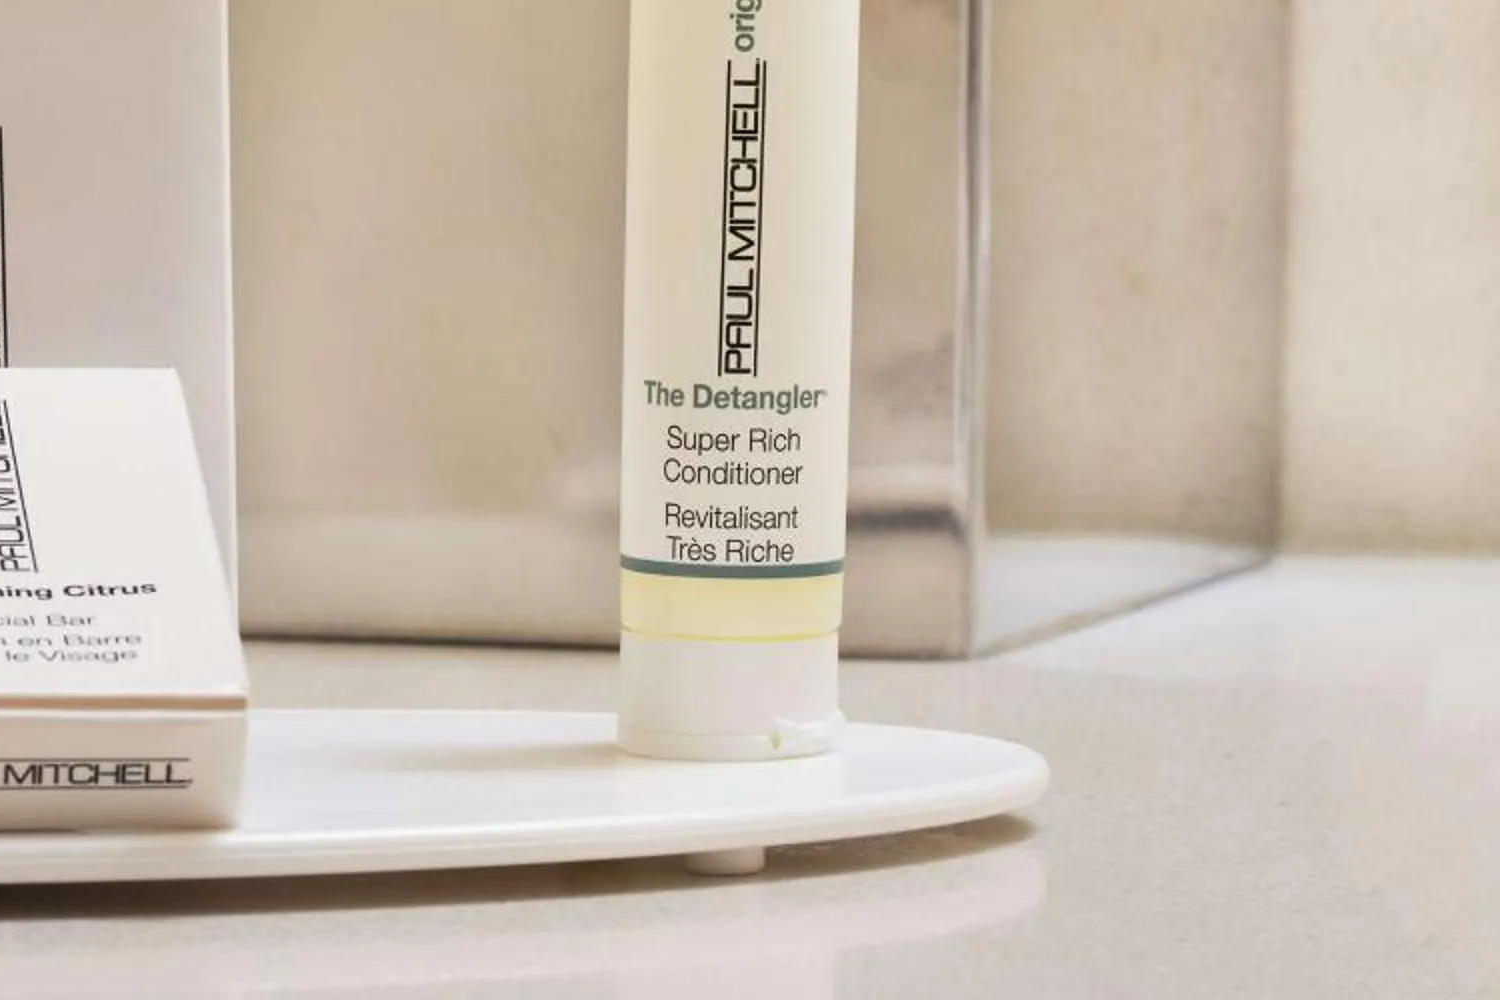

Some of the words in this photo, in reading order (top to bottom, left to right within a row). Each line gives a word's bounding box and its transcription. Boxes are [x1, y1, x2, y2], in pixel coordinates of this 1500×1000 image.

[728, 59, 760, 261] MITCHELL
[724, 268, 755, 375] PAUL
[643, 379, 685, 407] The
[692, 383, 821, 414] Detangler
[666, 425, 741, 456] Super
[748, 427, 801, 452] Rich
[662, 458, 804, 485] Conditioner
[664, 502, 799, 530] Revitalisant
[666, 535, 716, 562] Très
[725, 539, 795, 563] Riche
[62, 581, 158, 597] Citrus
[46, 613, 96, 627] Bar
[17, 634, 53, 647] en
[62, 632, 142, 647] Barre
[4, 648, 31, 662] le
[39, 648, 139, 664] Visage
[2, 763, 194, 786] MITCHELL
